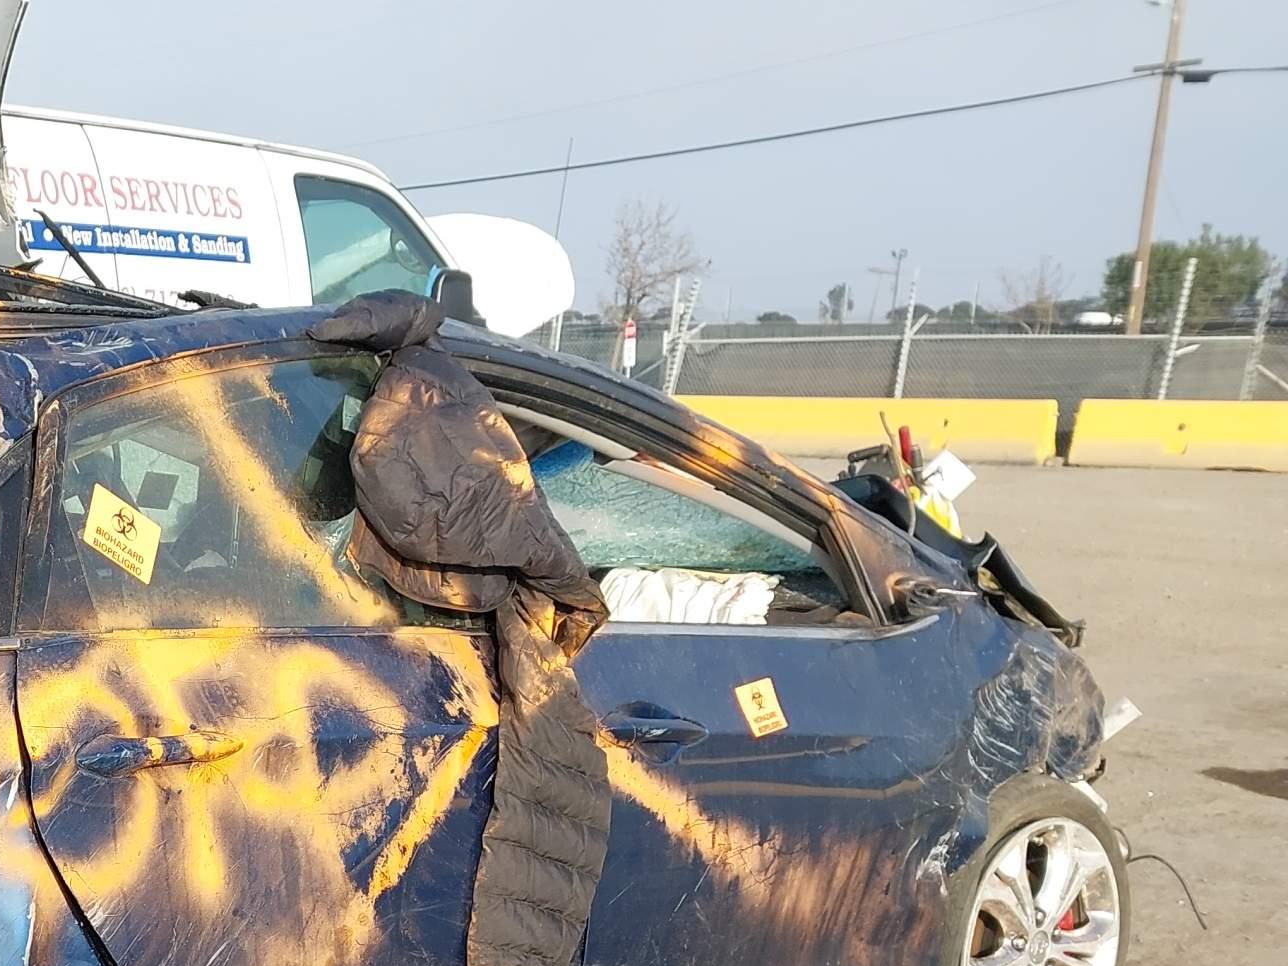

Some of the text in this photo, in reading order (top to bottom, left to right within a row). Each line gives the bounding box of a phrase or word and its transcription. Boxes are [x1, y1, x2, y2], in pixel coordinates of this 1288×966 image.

[109, 175, 243, 220] SERVICES
[61, 226, 92, 248] New
[94, 228, 176, 252] Installation
[177, 233, 191, 254] &
[191, 233, 246, 262] Sanding
[93, 537, 142, 577] BIOPELIGRO
[95, 526, 145, 565] BIOHAZARD
